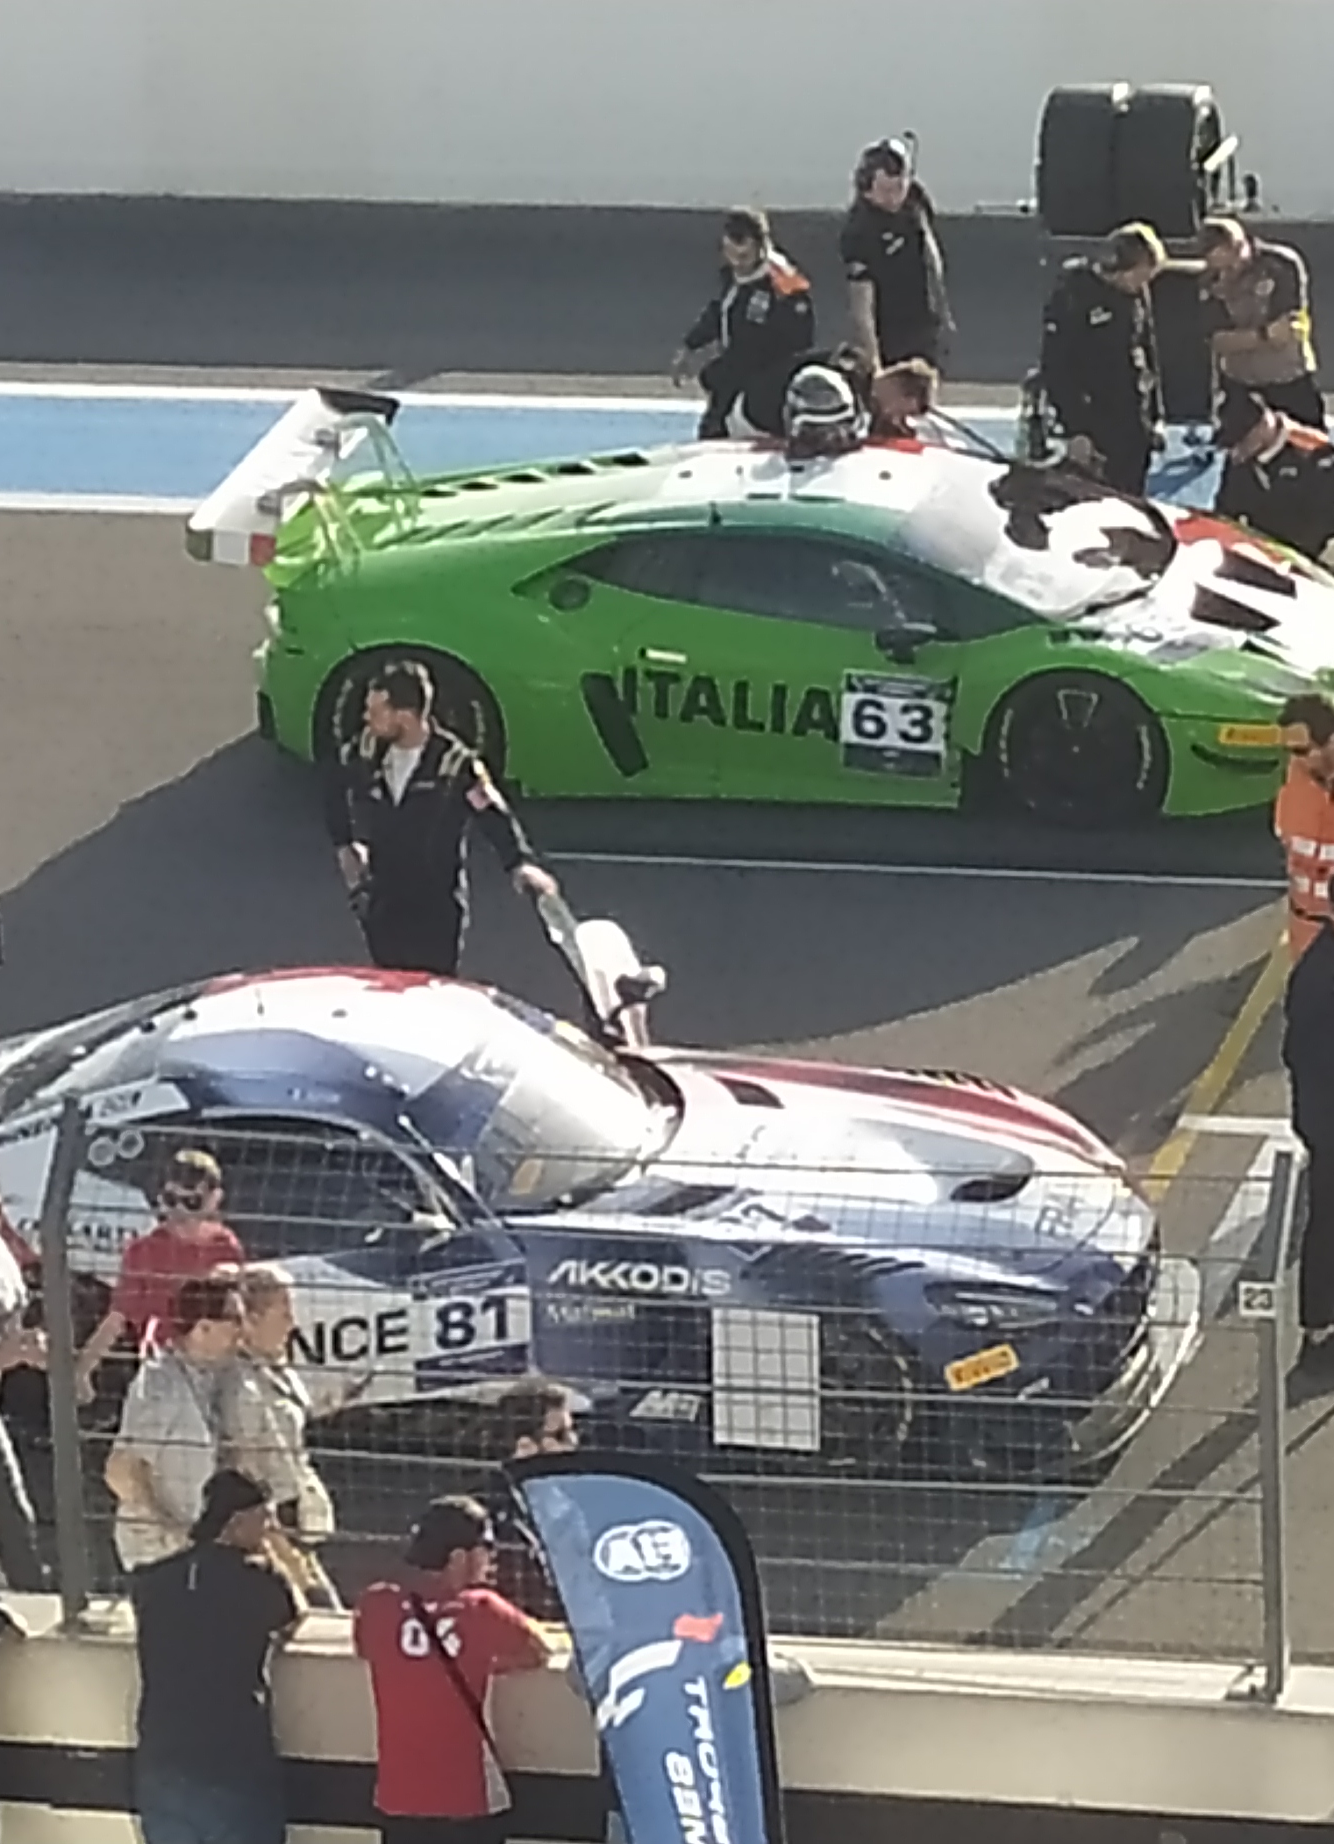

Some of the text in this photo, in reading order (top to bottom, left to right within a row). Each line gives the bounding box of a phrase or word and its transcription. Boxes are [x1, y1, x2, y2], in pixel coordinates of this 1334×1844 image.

[621, 666, 839, 743] ITALIA
[852, 698, 934, 744] 63
[548, 1259, 732, 1296] AKKODIS
[1243, 1287, 1273, 1310] 23
[435, 1295, 508, 1350] 81
